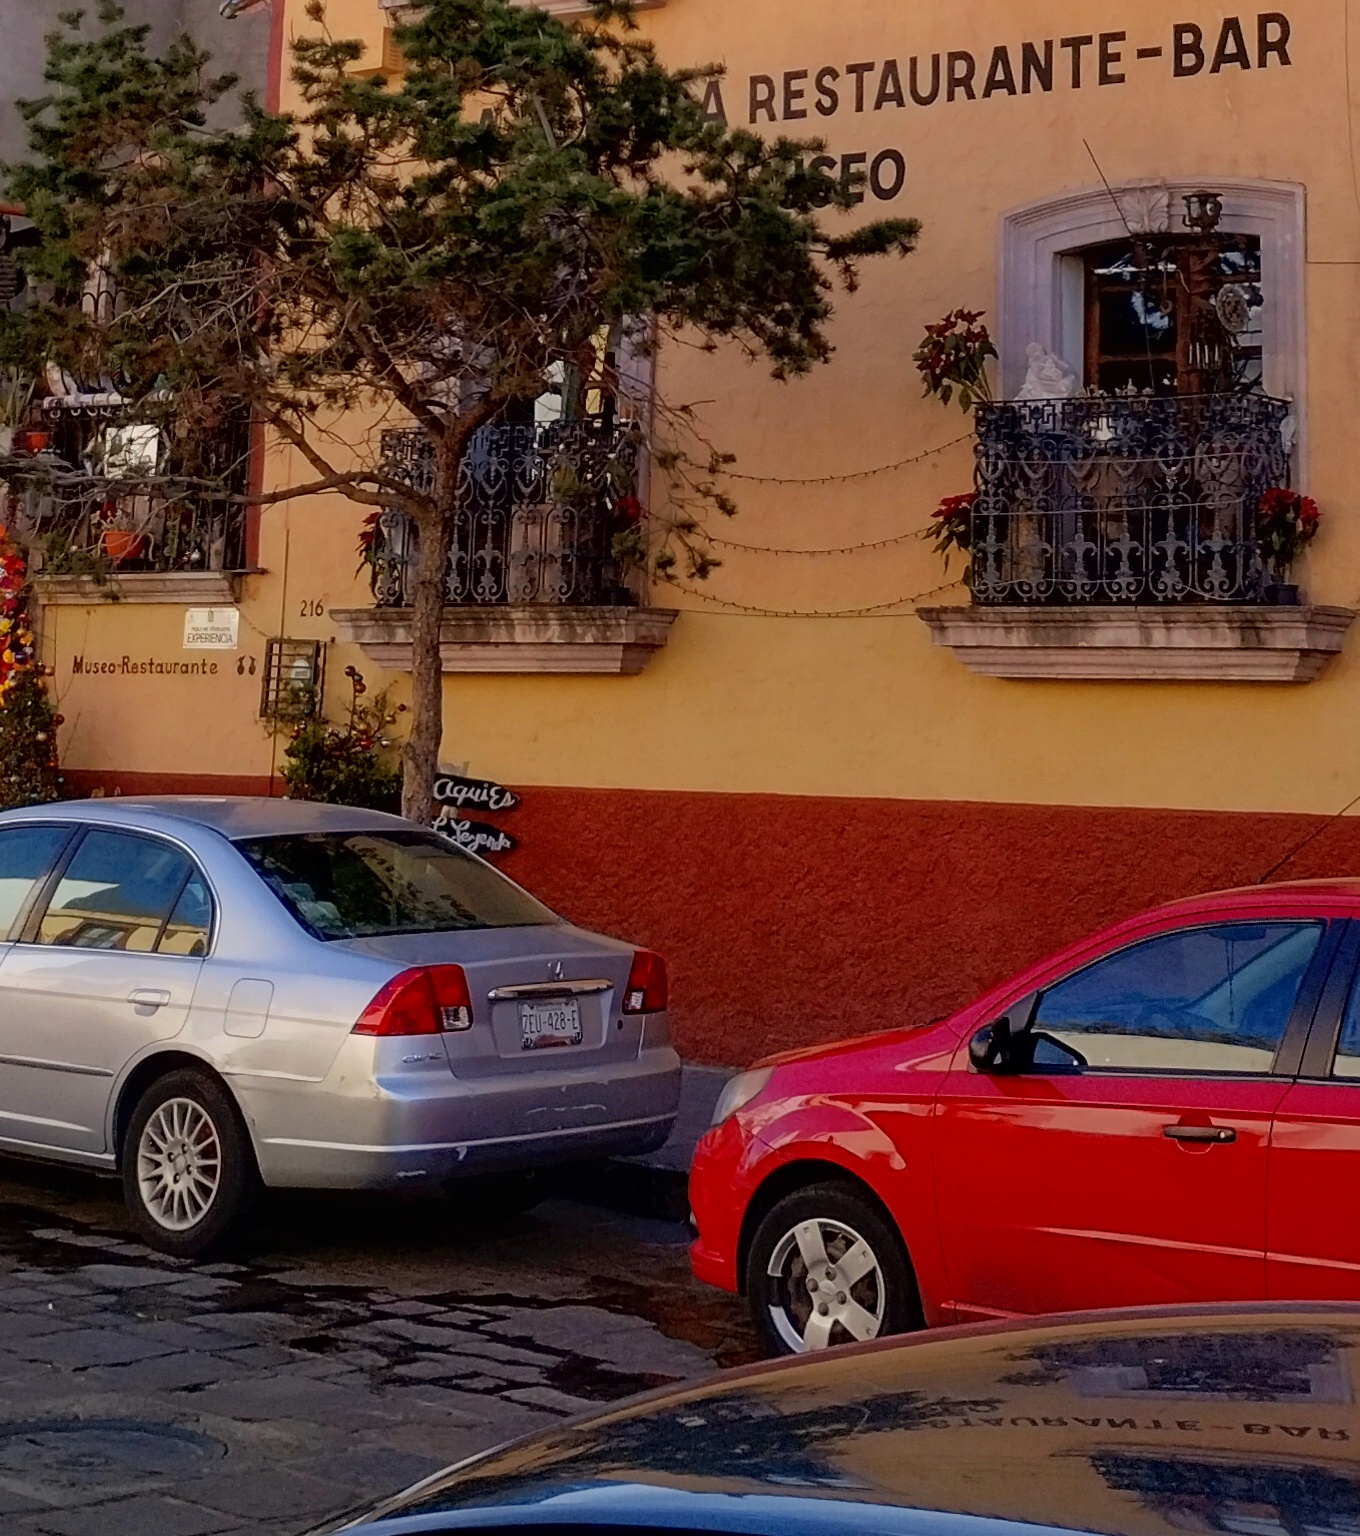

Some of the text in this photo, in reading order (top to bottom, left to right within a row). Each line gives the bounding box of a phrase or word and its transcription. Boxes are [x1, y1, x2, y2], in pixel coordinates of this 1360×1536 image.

[748, 12, 1293, 125] RESTAURANTE-BAR
[300, 599, 325, 618] 216
[72, 654, 219, 675] Museo-Restaurante
